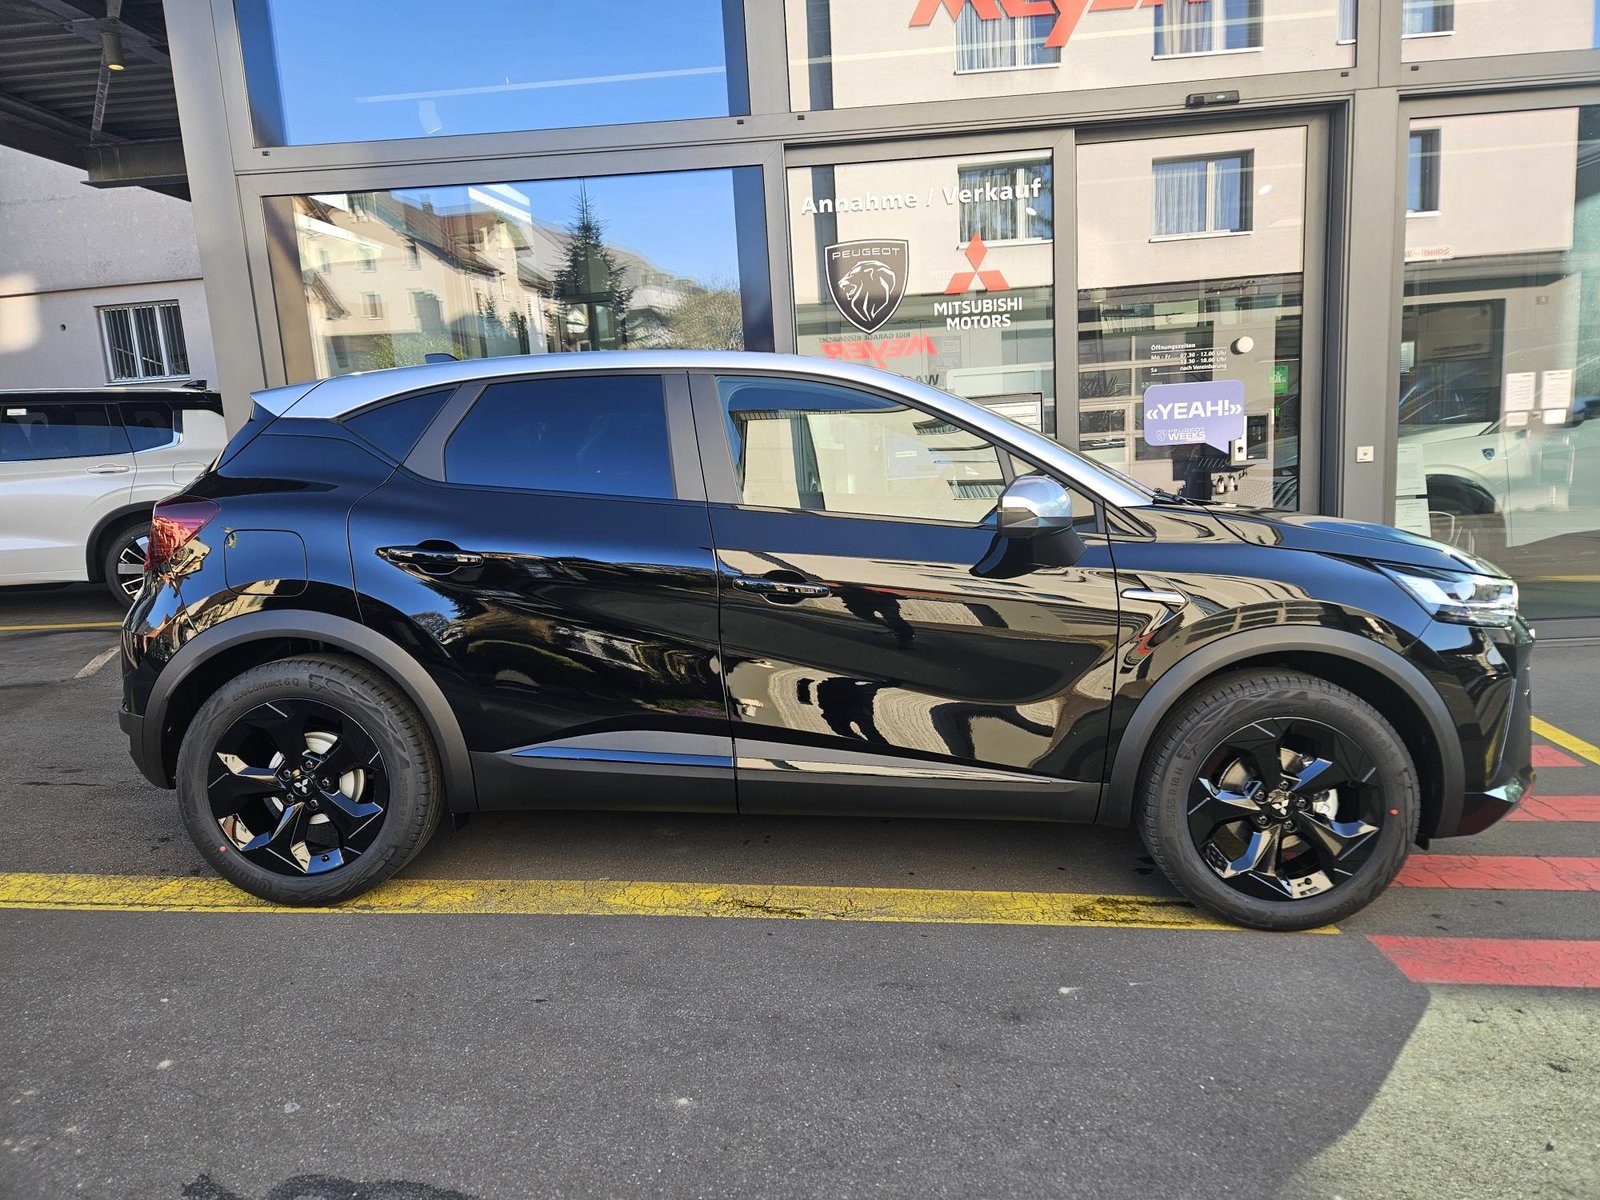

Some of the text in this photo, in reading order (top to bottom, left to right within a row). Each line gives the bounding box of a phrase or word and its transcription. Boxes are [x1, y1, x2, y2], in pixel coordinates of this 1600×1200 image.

[801, 177, 1041, 216] Annahme / Verkauf
[832, 248, 900, 260] PEUGEOT
[933, 297, 1023, 316] MITSUBISHI
[946, 314, 1011, 331] MOTORS
[1150, 343, 1196, 351] Öffnungszeiten
[1168, 431, 1206, 440] WEEKS
